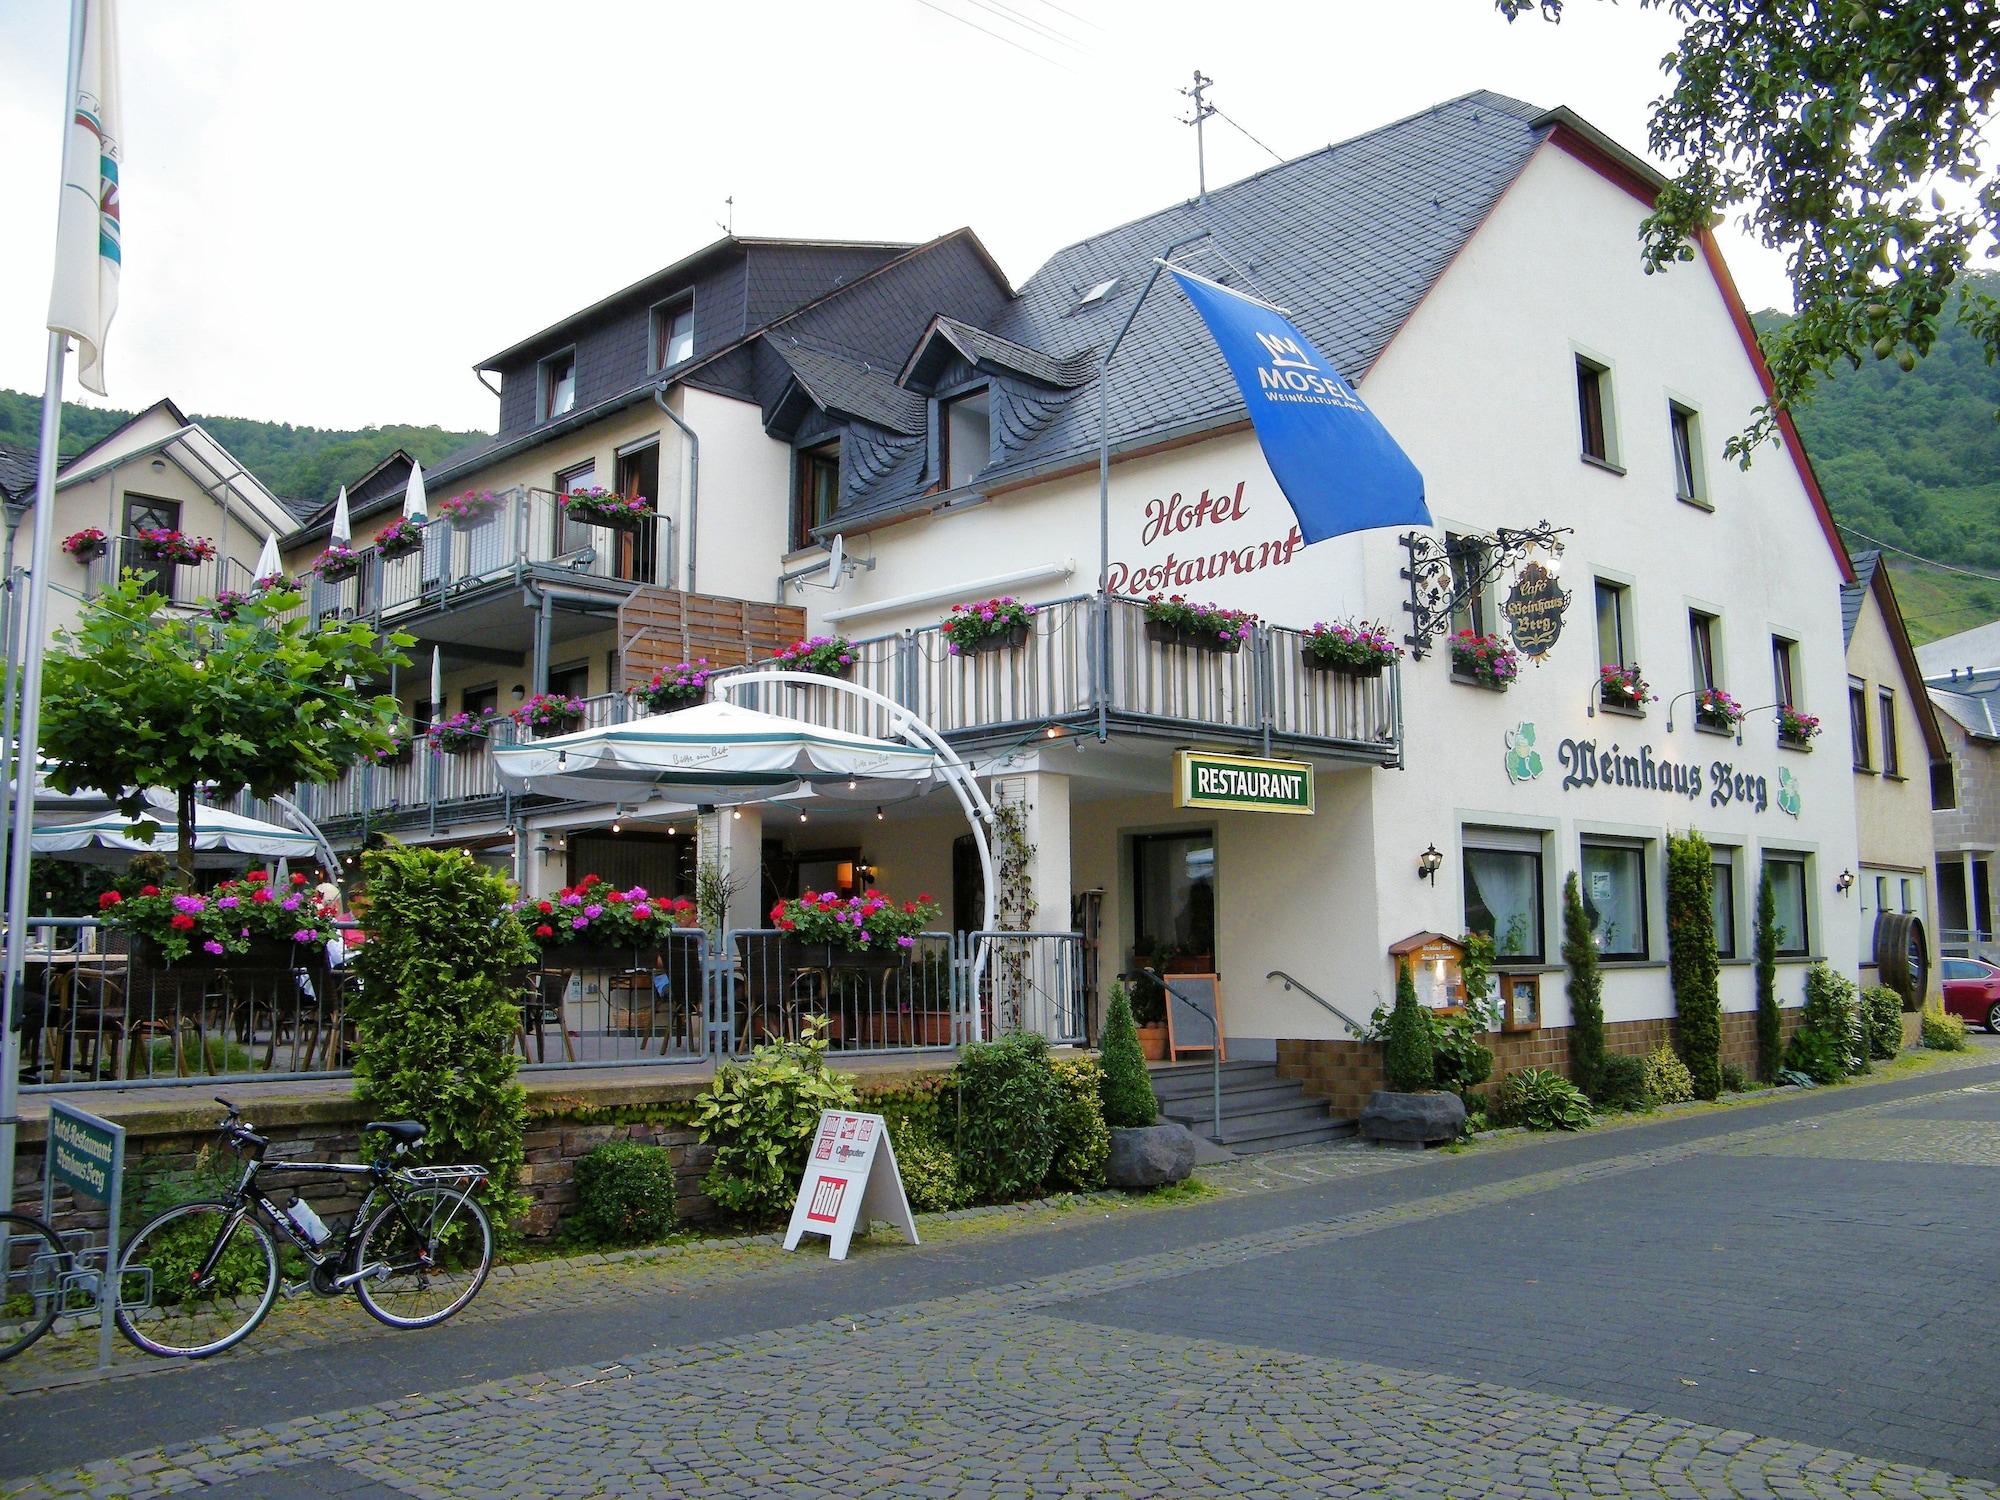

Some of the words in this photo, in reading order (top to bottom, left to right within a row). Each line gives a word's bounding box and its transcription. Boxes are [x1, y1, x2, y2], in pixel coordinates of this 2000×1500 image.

[1258, 367, 1357, 402] MOSEL
[1142, 481, 1250, 546] Hotel
[1099, 525, 1307, 595] Restaurant
[1520, 579, 1548, 597] Café
[1507, 597, 1564, 616] Weinhaus
[1517, 616, 1551, 632] Berg
[1198, 767, 1302, 800] RESTAURANT
[1558, 738, 1701, 800] Weinhaus
[1710, 761, 1768, 813] Berg
[84, 1161, 105, 1193] Berg
